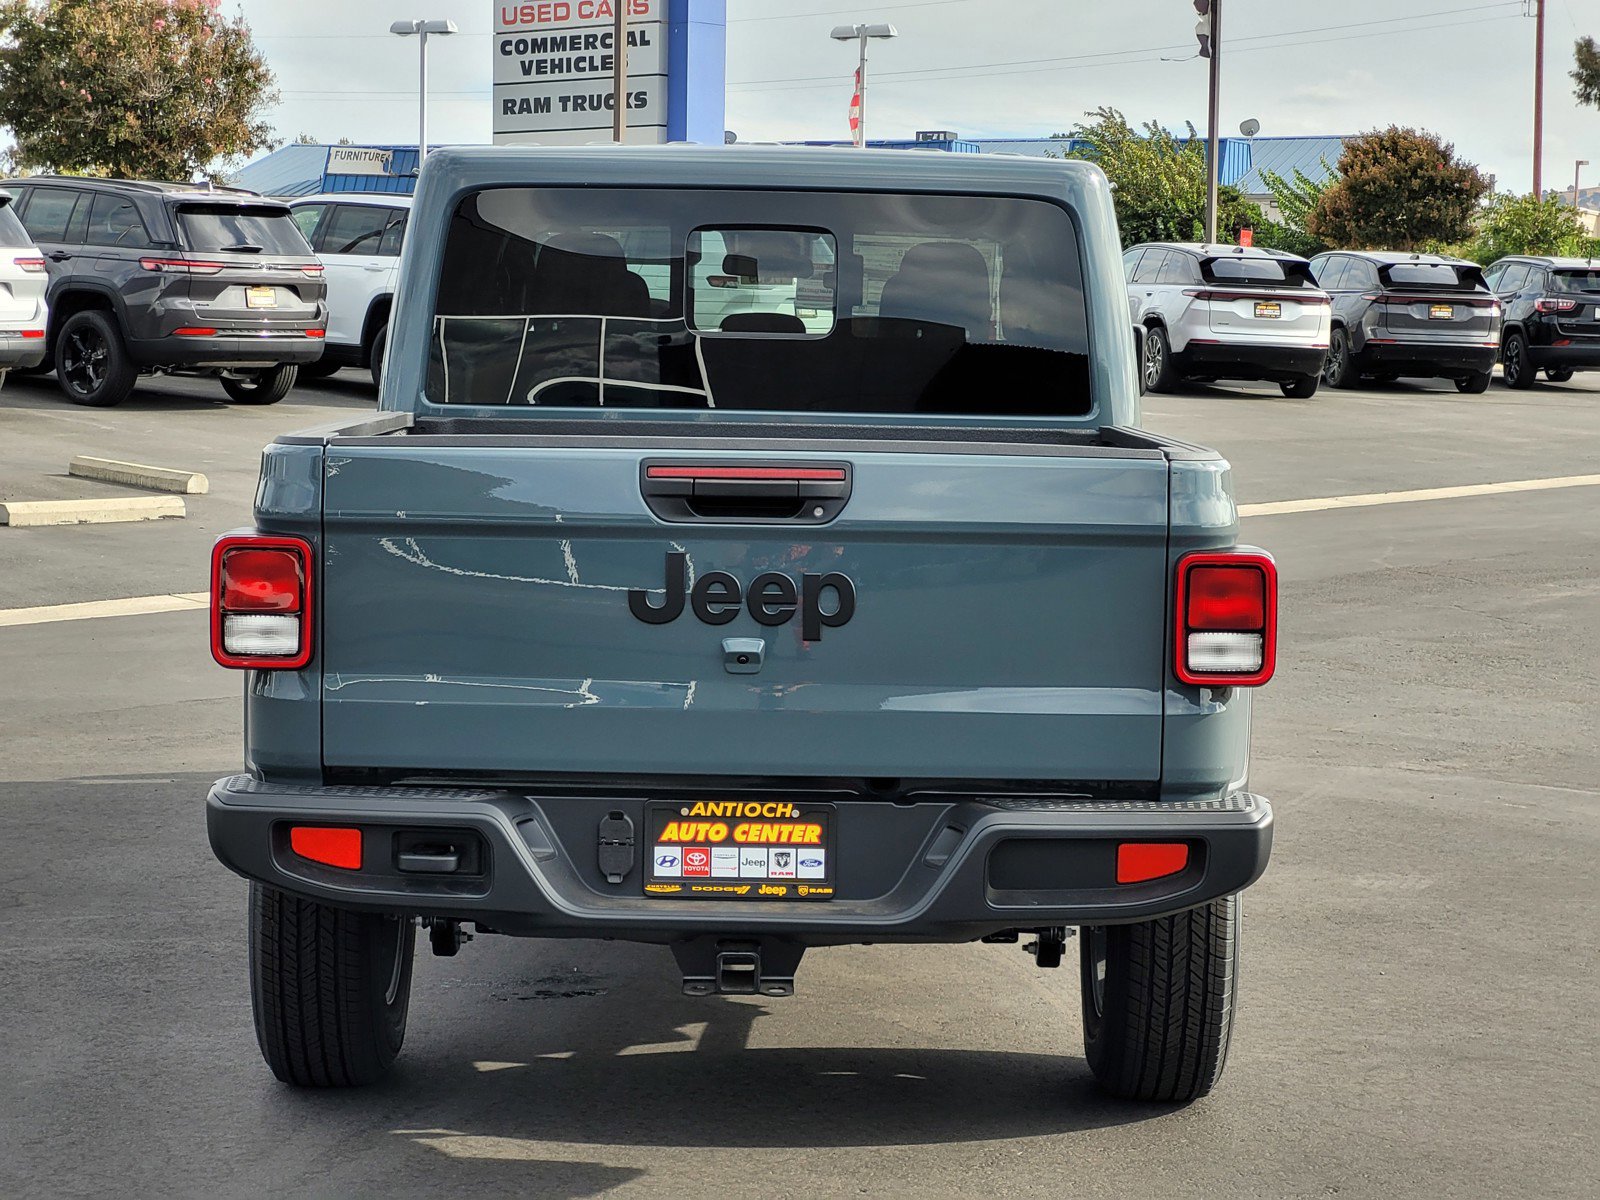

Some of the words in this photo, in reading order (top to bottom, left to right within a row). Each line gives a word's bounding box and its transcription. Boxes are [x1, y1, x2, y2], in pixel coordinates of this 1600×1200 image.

[502, 3, 570, 25] USED
[500, 30, 650, 55] COMMERCAL
[520, 53, 628, 76] VEHICLE
[502, 97, 551, 115] RAM
[334, 150, 386, 162] FURNITURE
[628, 550, 856, 641] Jeep
[689, 802, 793, 818] ANTIOCH
[658, 822, 729, 842] AUTO
[733, 823, 821, 844] CENTER
[742, 857, 766, 868] Jeep
[758, 884, 787, 896] Jeep
